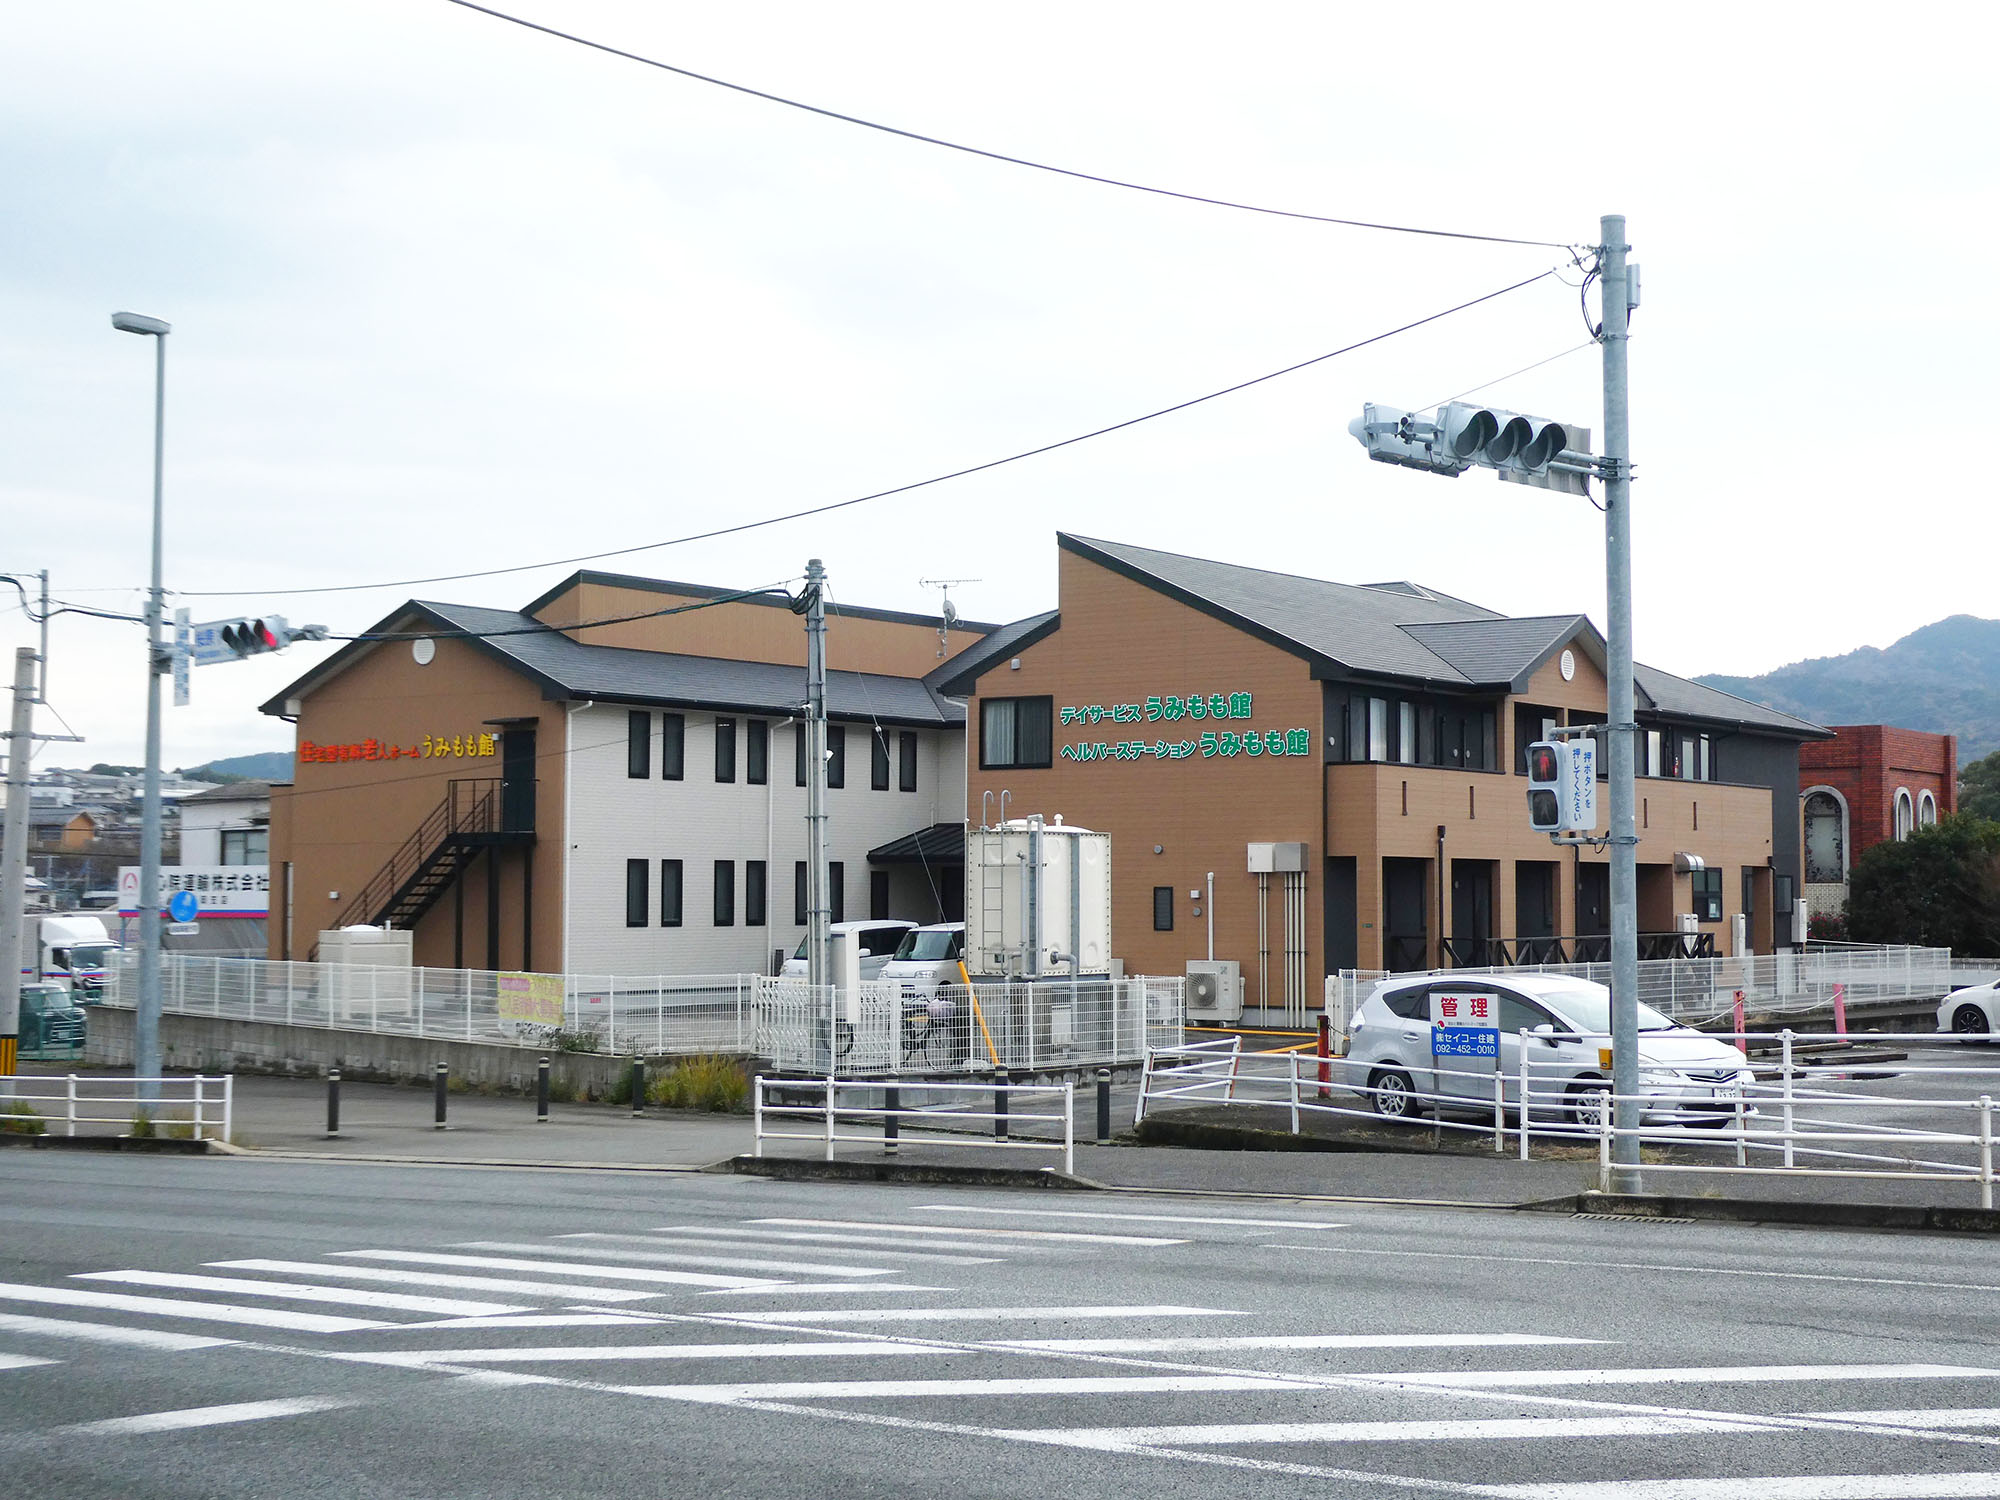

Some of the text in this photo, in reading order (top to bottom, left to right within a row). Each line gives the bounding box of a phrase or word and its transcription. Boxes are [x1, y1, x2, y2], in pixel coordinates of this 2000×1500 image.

[1060, 691, 1253, 726] デイサービス うみもも館
[422, 732, 496, 759] うみもも館
[1060, 728, 1310, 762] ヘルパーステーション うみもも館
[1572, 747, 1582, 822] 押してください
[1583, 751, 1592, 809] 押ボタンを
[1435, 1043, 1496, 1055] 092-452-0010
